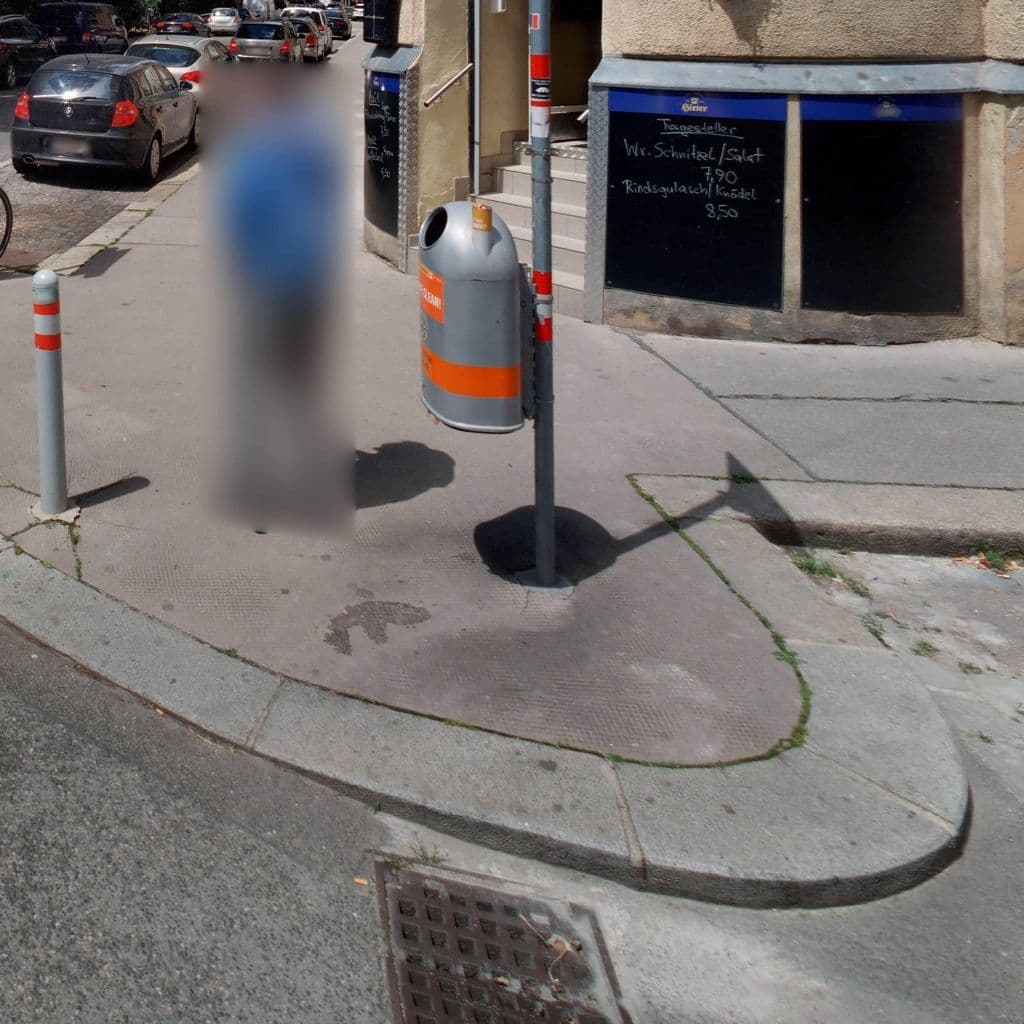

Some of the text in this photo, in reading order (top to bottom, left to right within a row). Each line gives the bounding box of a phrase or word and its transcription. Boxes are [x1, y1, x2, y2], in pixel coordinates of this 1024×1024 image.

[656, 118, 737, 137] Tagesteller
[701, 166, 738, 184] 7,90
[705, 203, 738, 220] 8,50
